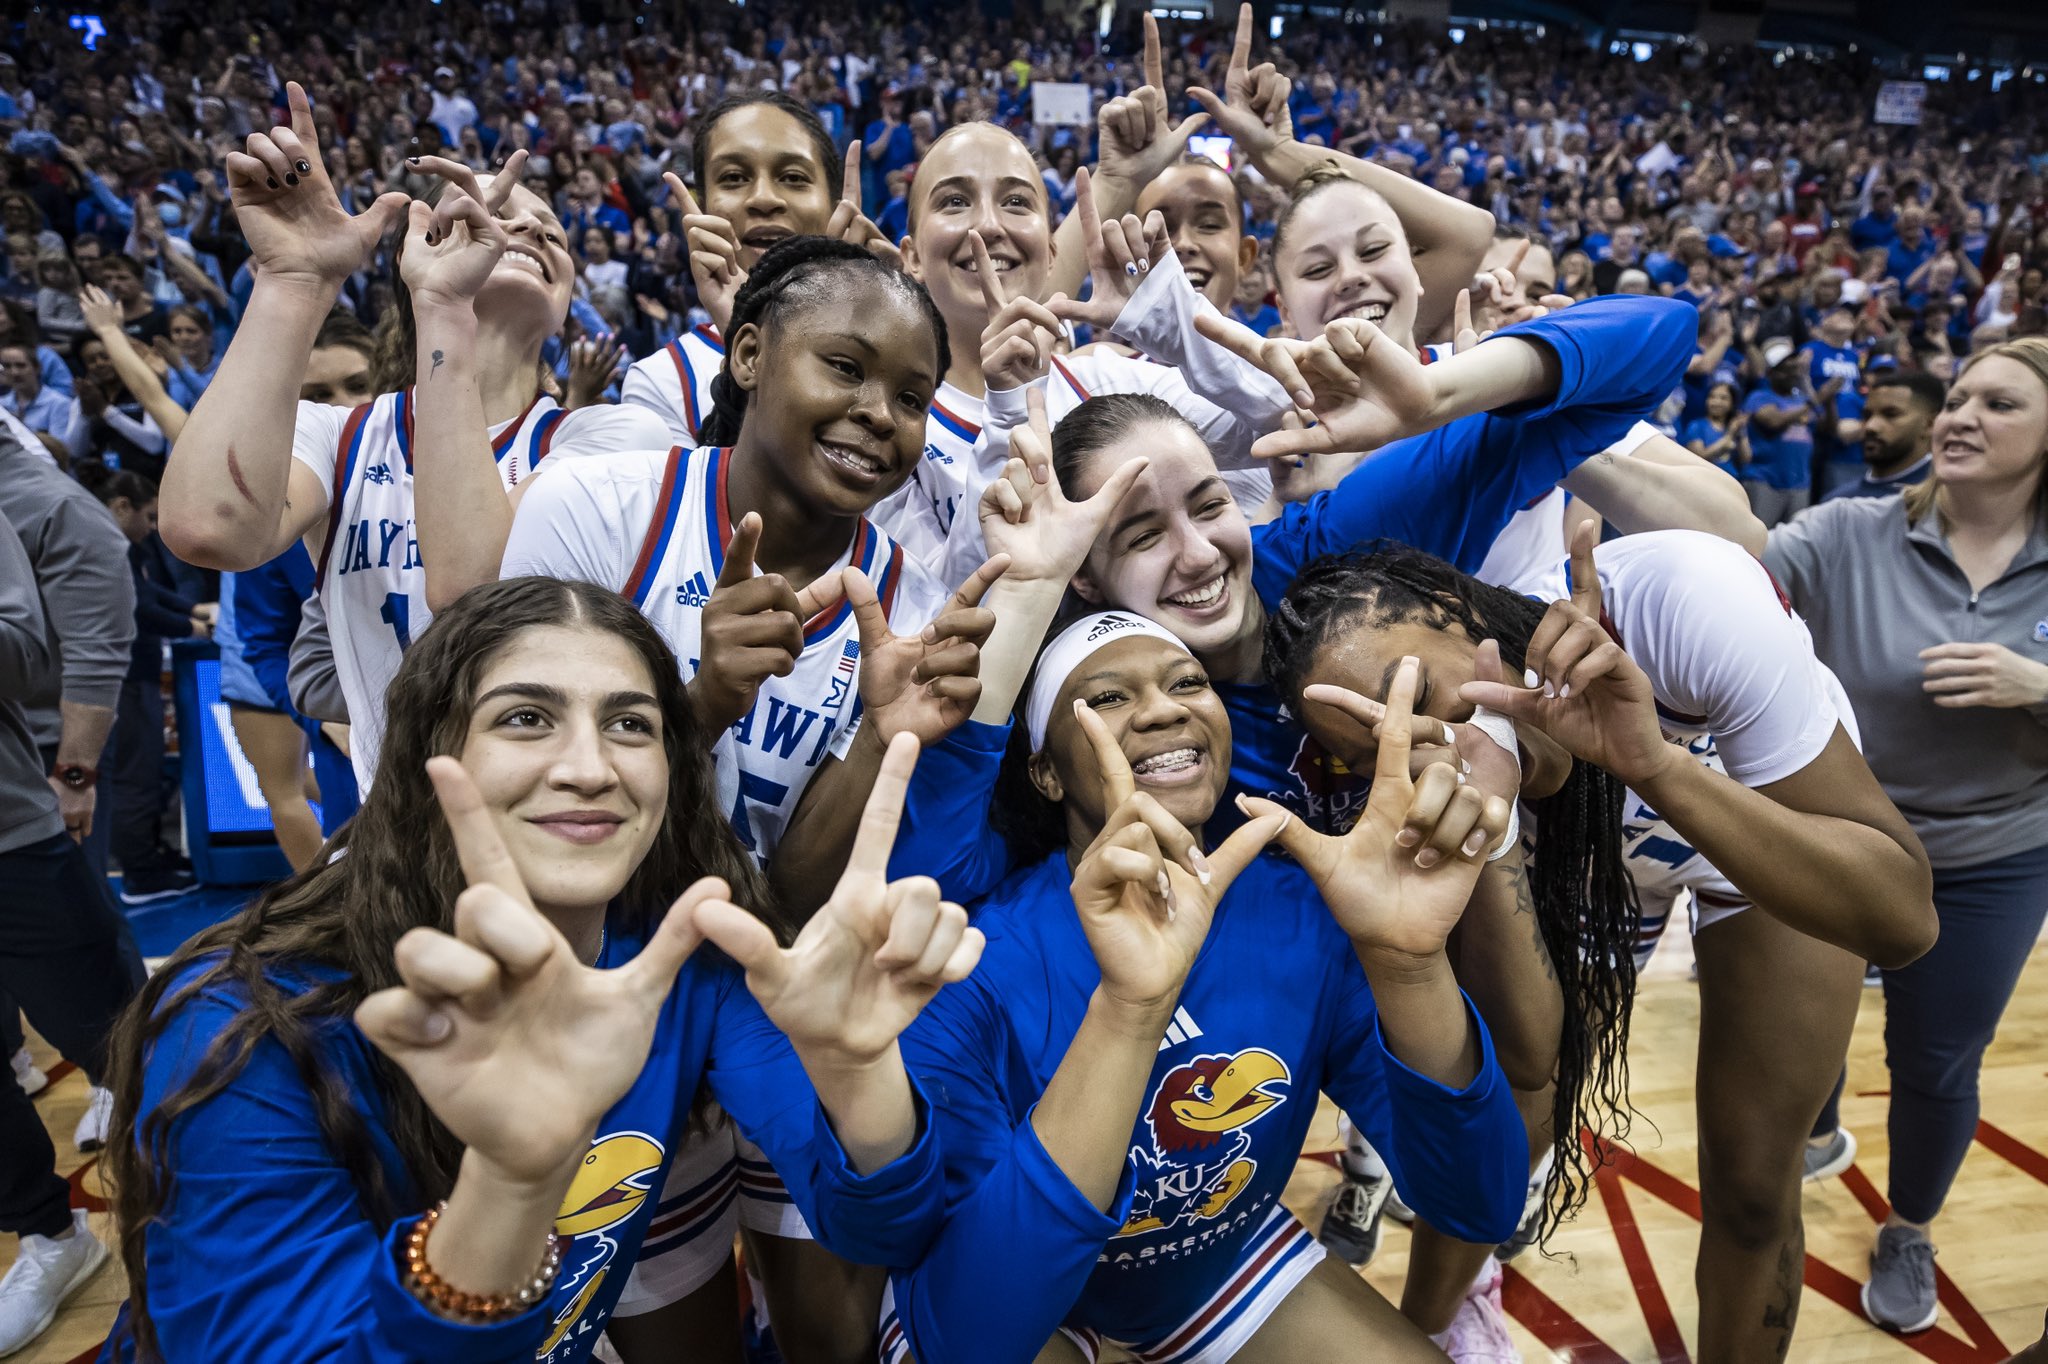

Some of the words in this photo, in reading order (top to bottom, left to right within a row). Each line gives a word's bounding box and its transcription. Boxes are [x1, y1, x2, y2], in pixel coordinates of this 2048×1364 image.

[1087, 621, 1146, 641] adidas
[1155, 1163, 1206, 1202] KU
[1097, 1191, 1272, 1263] BASKETBALL
[1121, 1258, 1158, 1271] NEW
